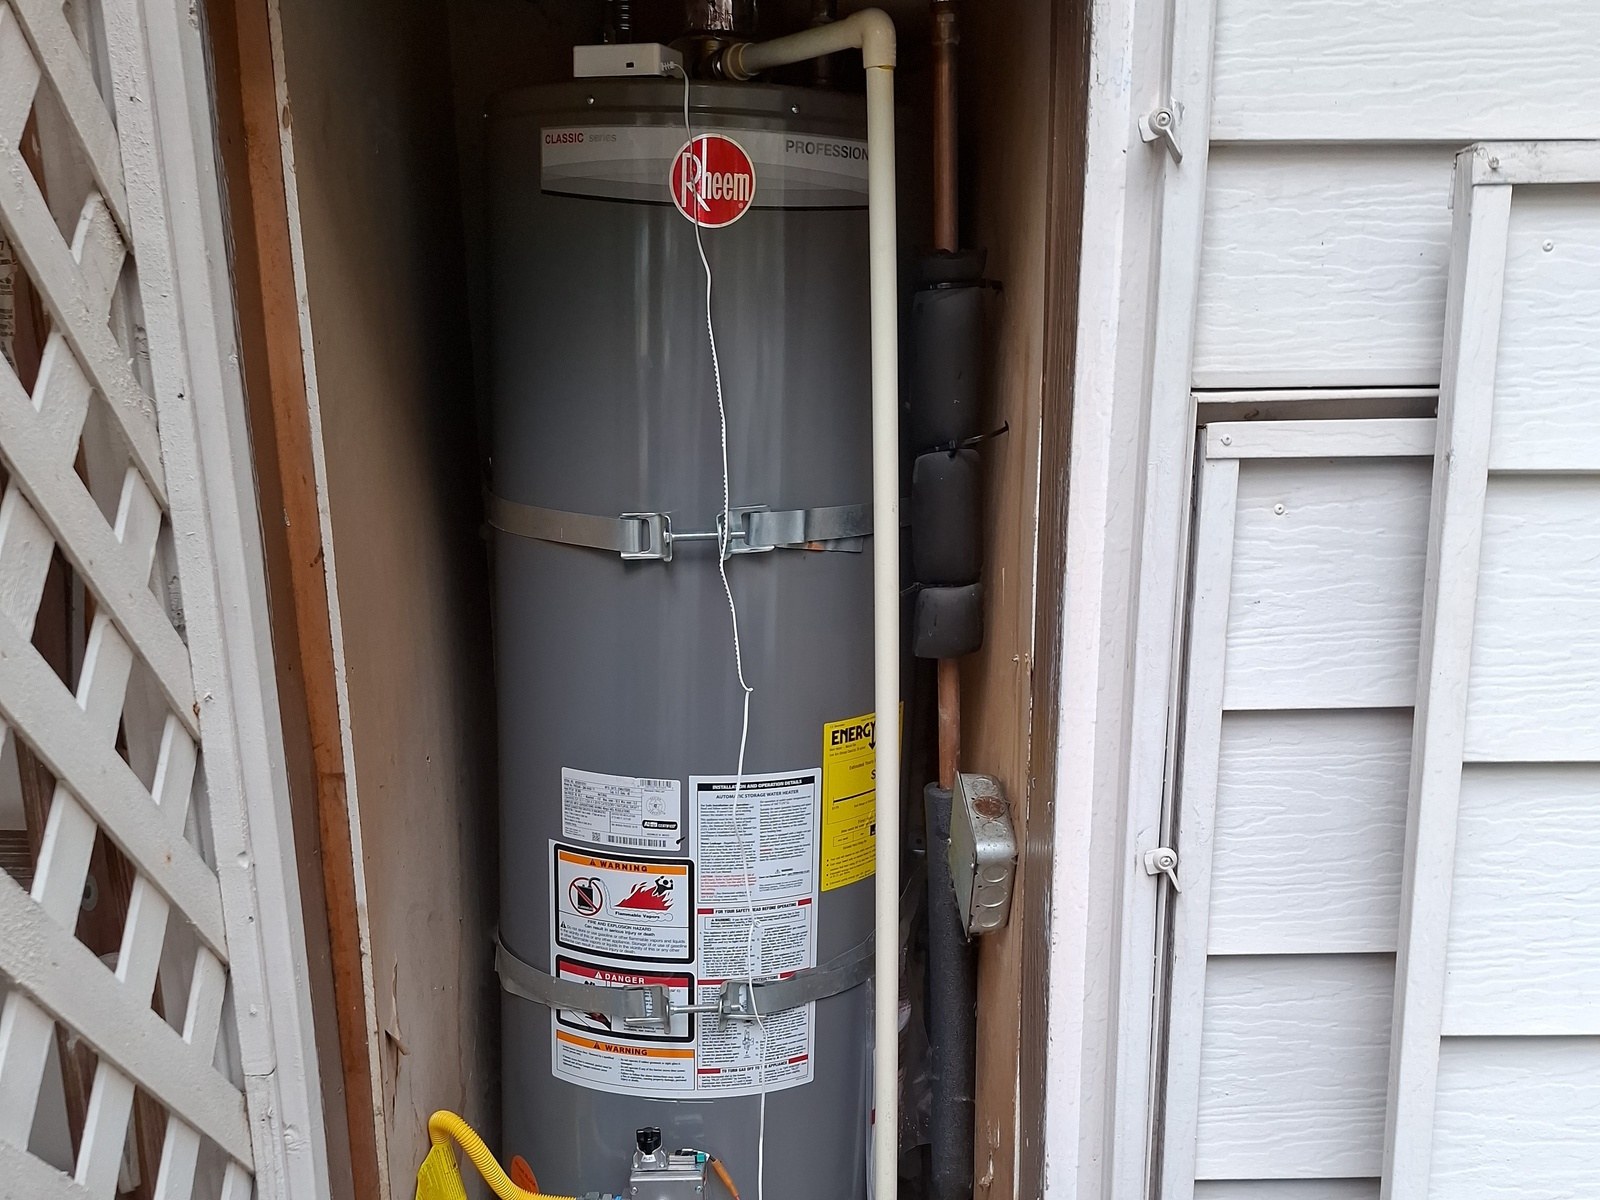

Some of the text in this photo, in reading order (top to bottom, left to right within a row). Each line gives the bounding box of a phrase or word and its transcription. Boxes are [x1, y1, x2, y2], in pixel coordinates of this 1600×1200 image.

[545, 132, 585, 144] CLASSIC
[681, 138, 750, 212] Rheem
[831, 720, 876, 748] ENERGY
[712, 782, 746, 790] INSTALLAON
[600, 860, 648, 872] WARNING
[604, 973, 645, 984] DANGER
[605, 1044, 648, 1056] WARNING
